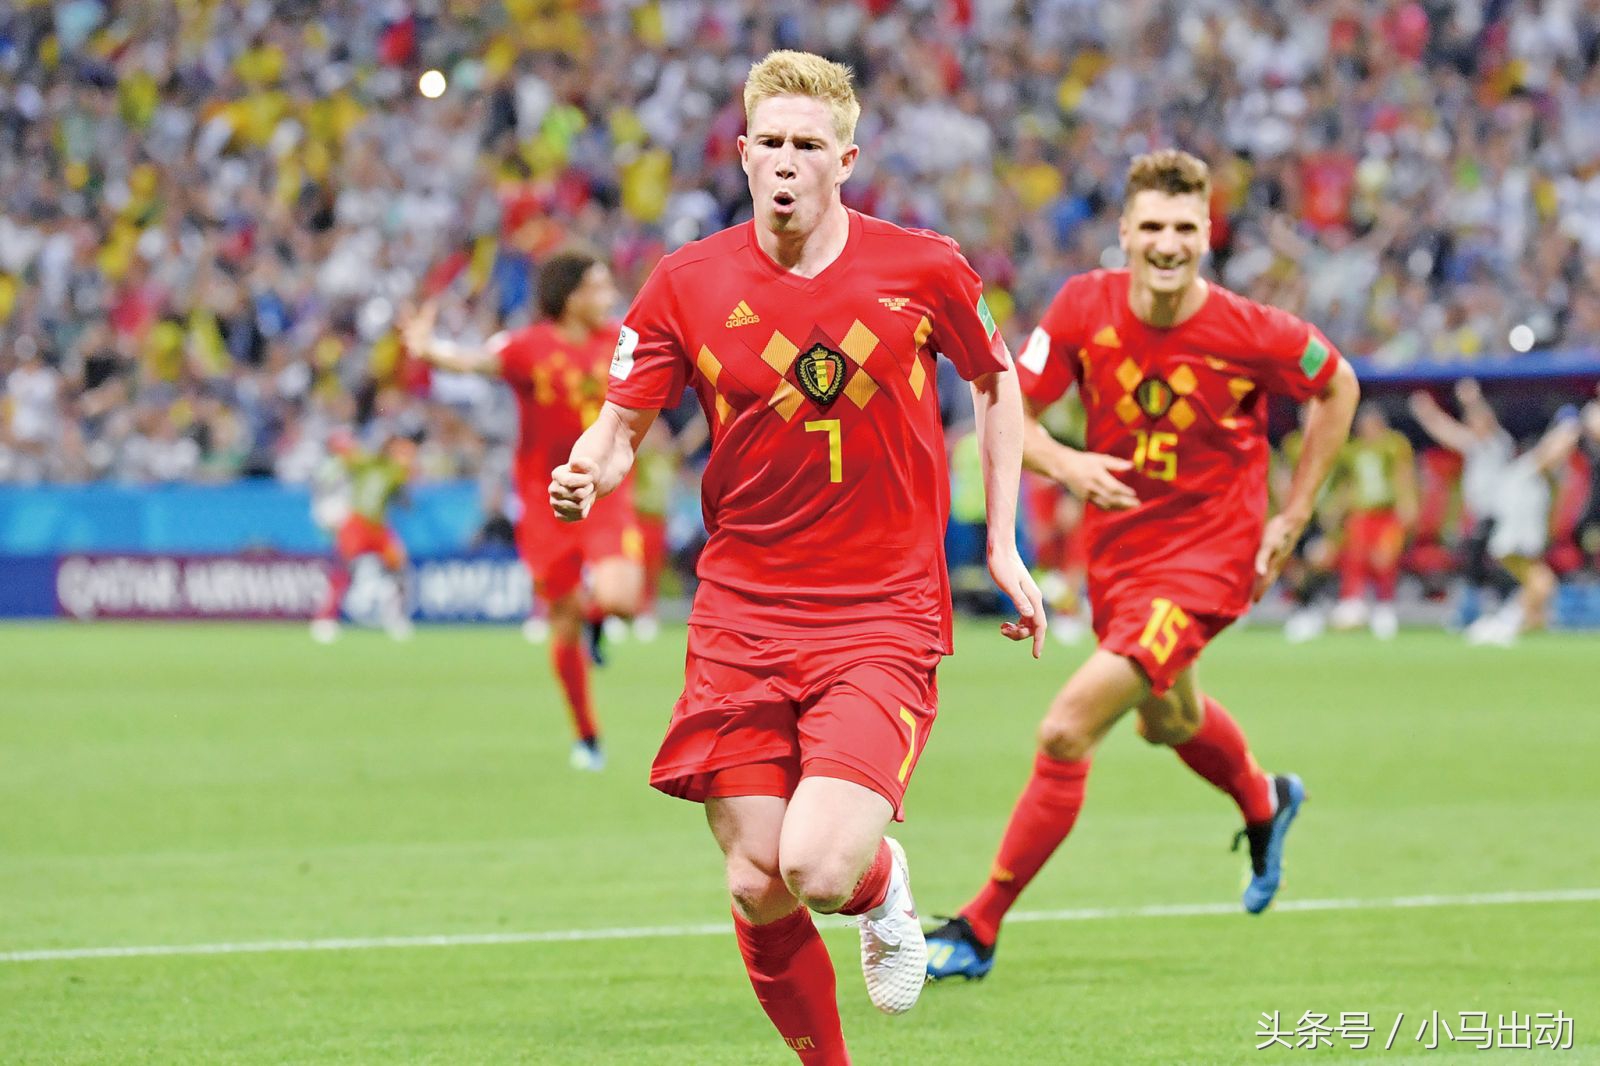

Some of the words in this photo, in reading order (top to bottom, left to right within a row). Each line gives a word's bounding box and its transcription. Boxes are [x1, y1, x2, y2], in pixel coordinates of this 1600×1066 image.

[725, 314, 760, 328] adidas
[805, 418, 842, 483] 7
[1132, 430, 1178, 482] 15
[1139, 597, 1191, 665] 15
[898, 706, 916, 783] 7
